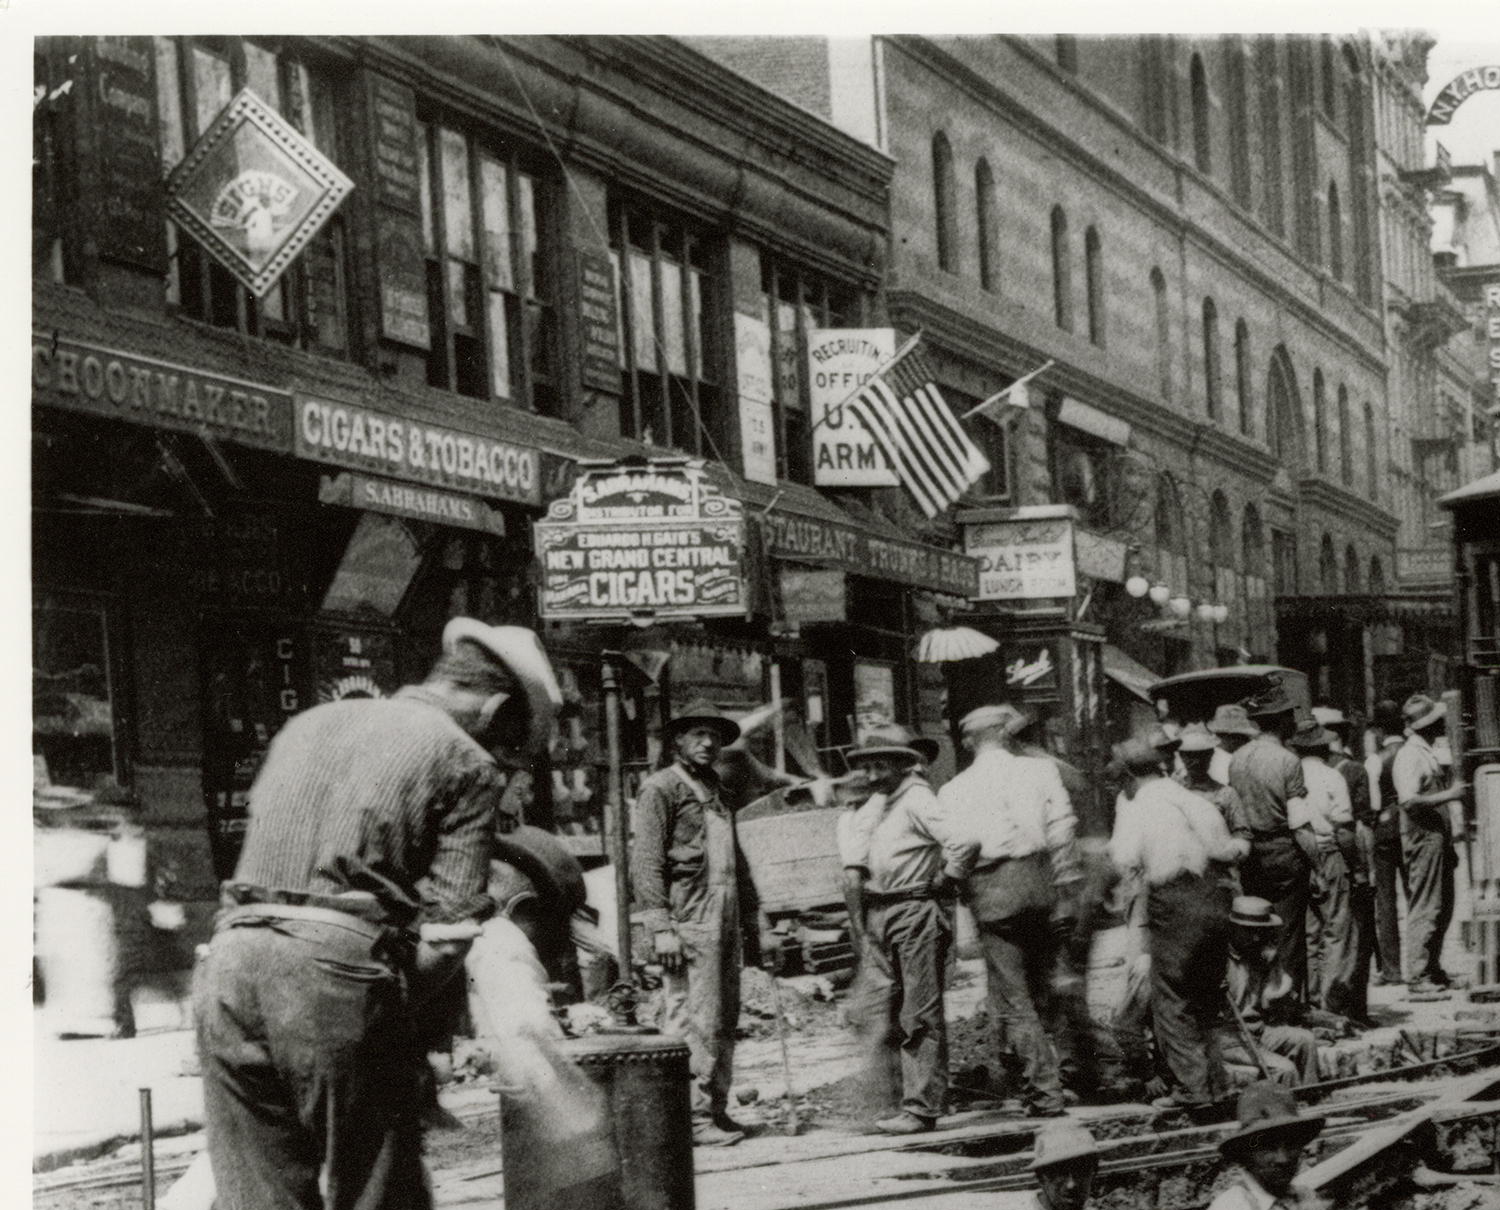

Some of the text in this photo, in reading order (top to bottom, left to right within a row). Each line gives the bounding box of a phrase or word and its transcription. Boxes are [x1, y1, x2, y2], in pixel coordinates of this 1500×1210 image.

[302, 401, 403, 462] CIGARS
[408, 427, 426, 467] &
[425, 430, 534, 490] TOBACCO
[547, 546, 738, 570] NEW GRAND CENTRAL
[590, 569, 695, 607] CIGARS
